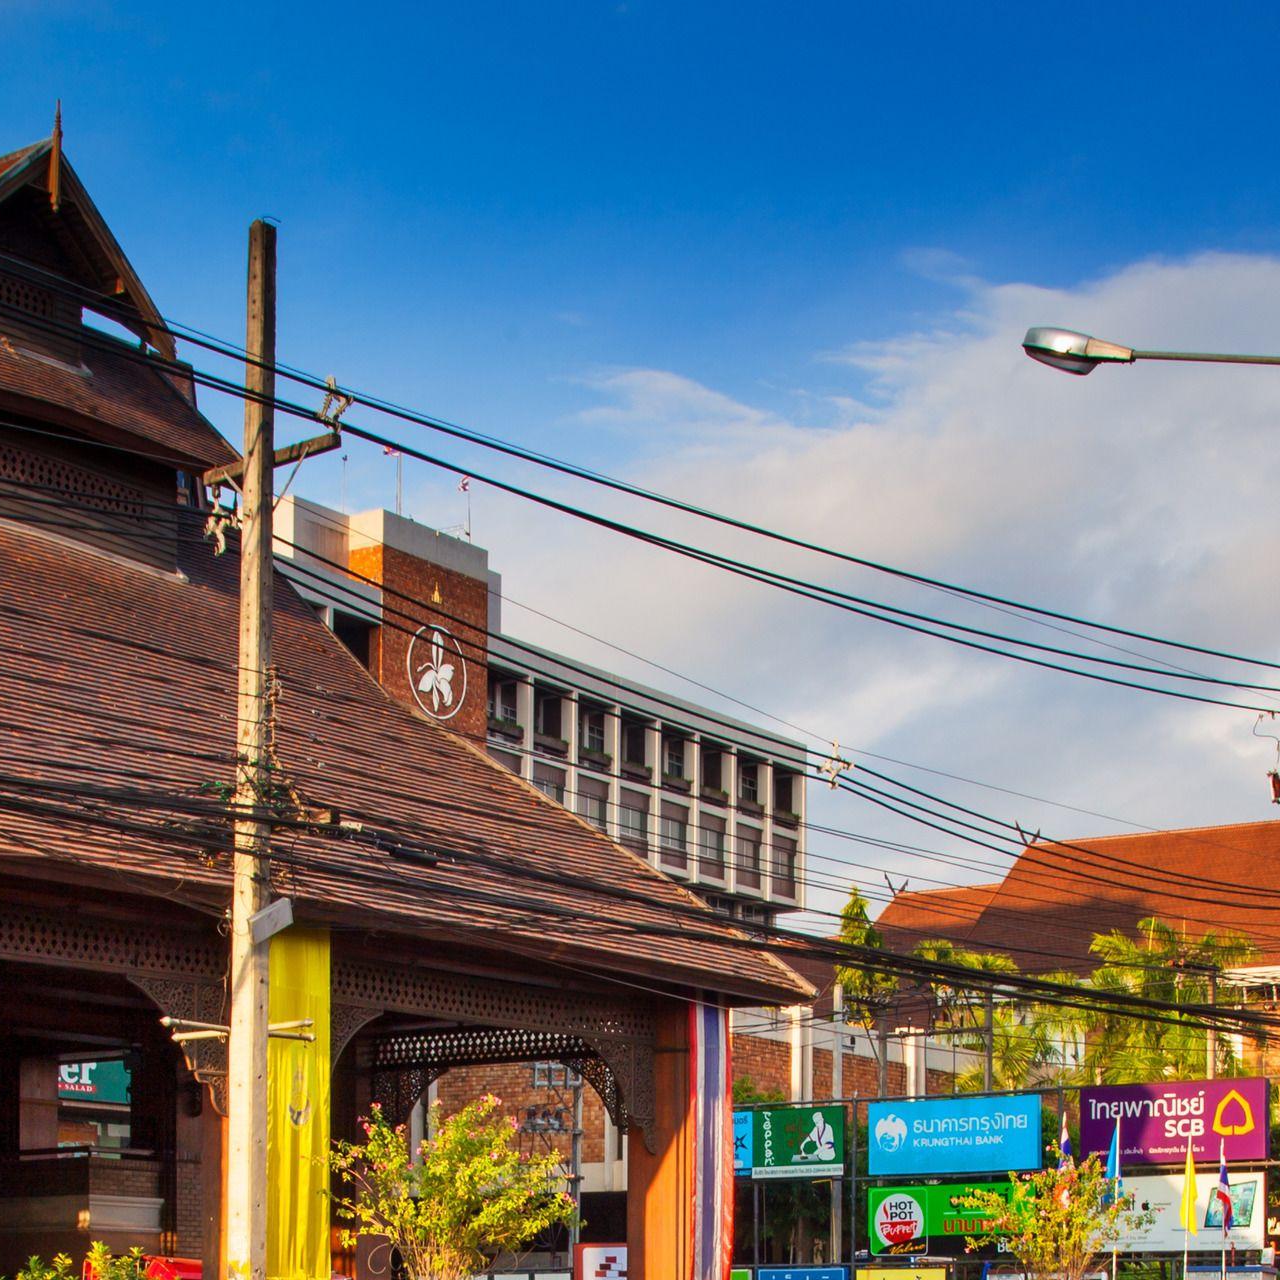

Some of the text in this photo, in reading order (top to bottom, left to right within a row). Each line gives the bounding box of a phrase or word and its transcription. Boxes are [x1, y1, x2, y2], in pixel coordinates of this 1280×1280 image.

[58, 1062, 97, 1084] er
[65, 1084, 93, 1092] SALAD
[1089, 1090, 1206, 1120] ไทยพาณิชย์
[913, 1112, 1028, 1134] ธนาคารกรุงไทย
[1165, 1119, 1205, 1138] SCB
[913, 1135, 1004, 1148] KRUNGTHAI BANK
[889, 1201, 914, 1211] HOT
[890, 1211, 914, 1221] POT
